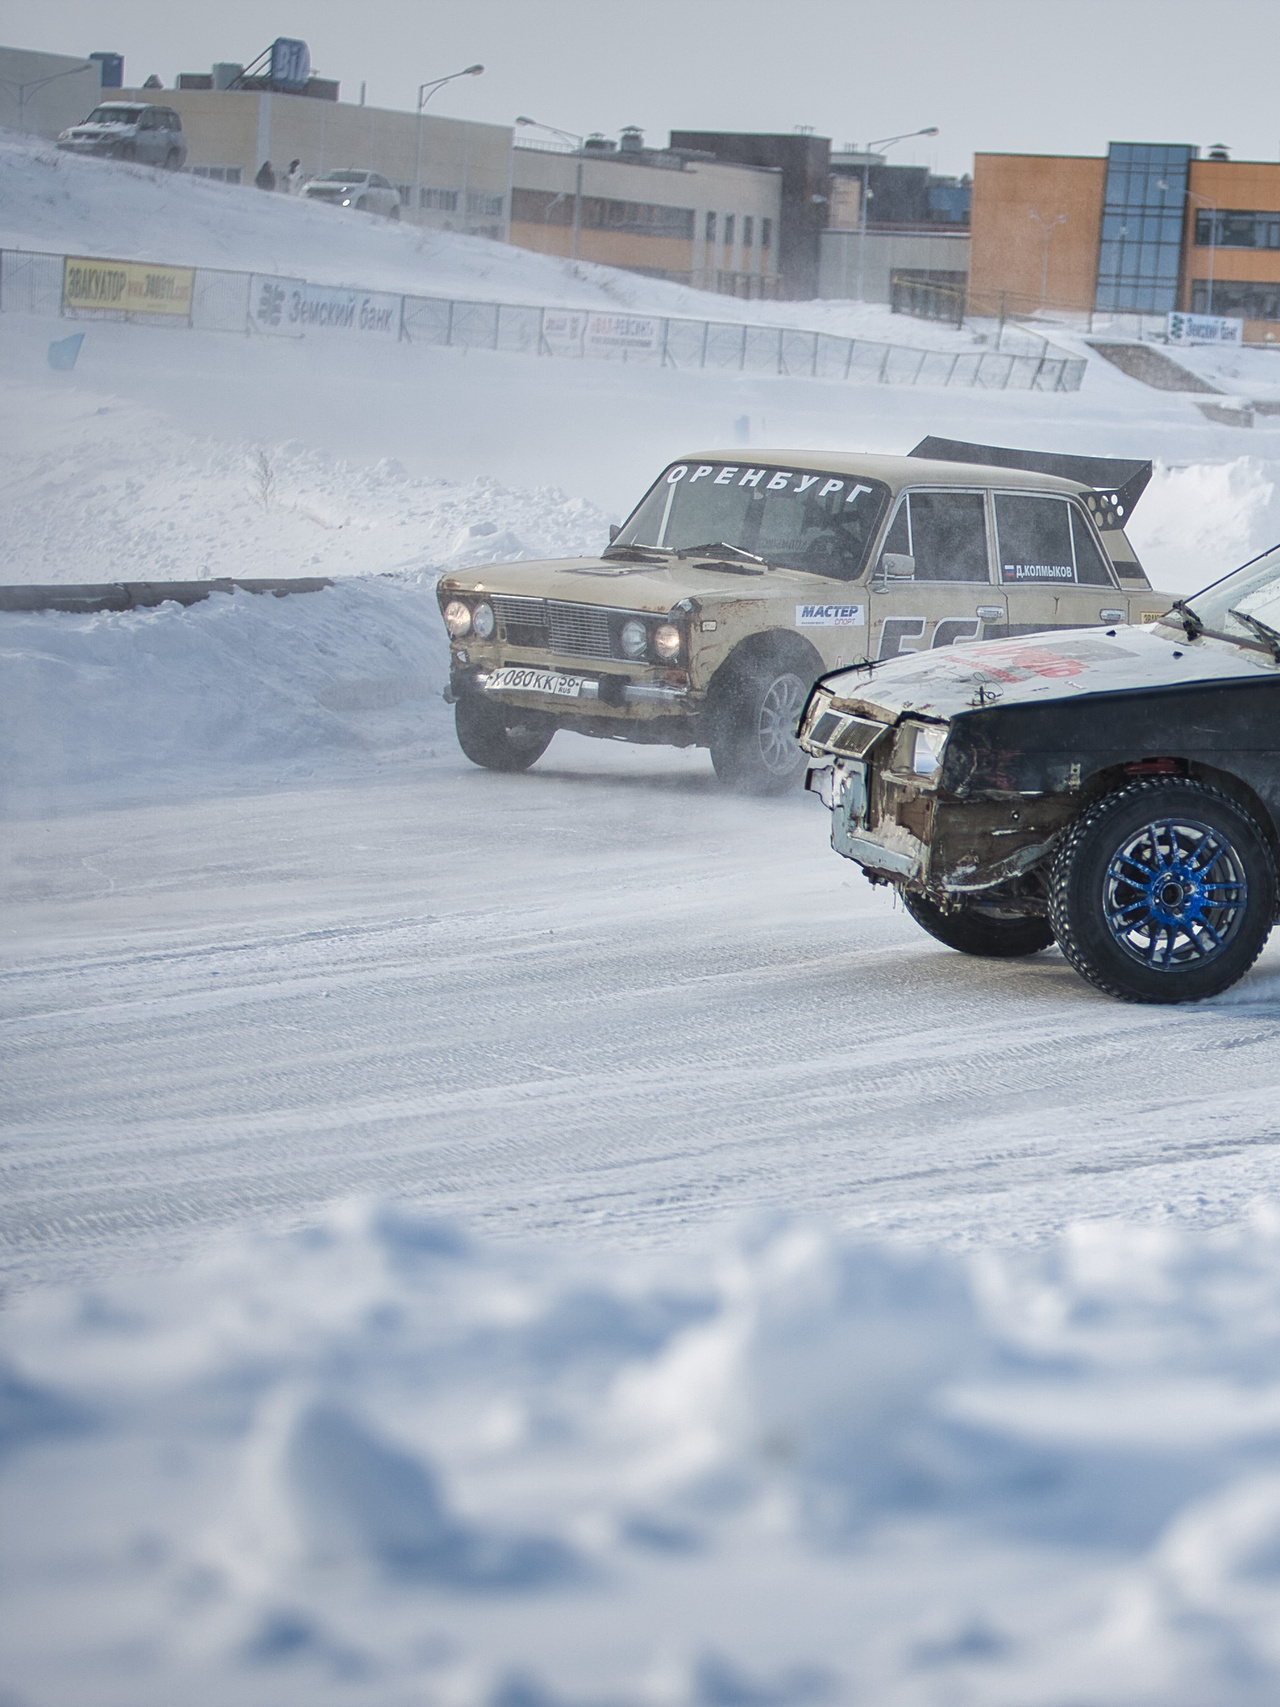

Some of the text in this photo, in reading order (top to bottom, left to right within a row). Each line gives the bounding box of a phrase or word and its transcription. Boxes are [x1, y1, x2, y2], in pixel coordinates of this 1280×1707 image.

[68, 266, 127, 301] ЭВАКУАТОР
[288, 289, 394, 331] Земский банк
[666, 465, 873, 503] ОРЕНБУРГ
[1016, 564, 1073, 579] Д.КОЛМЫКОВ
[801, 605, 859, 618] МАСТЕР
